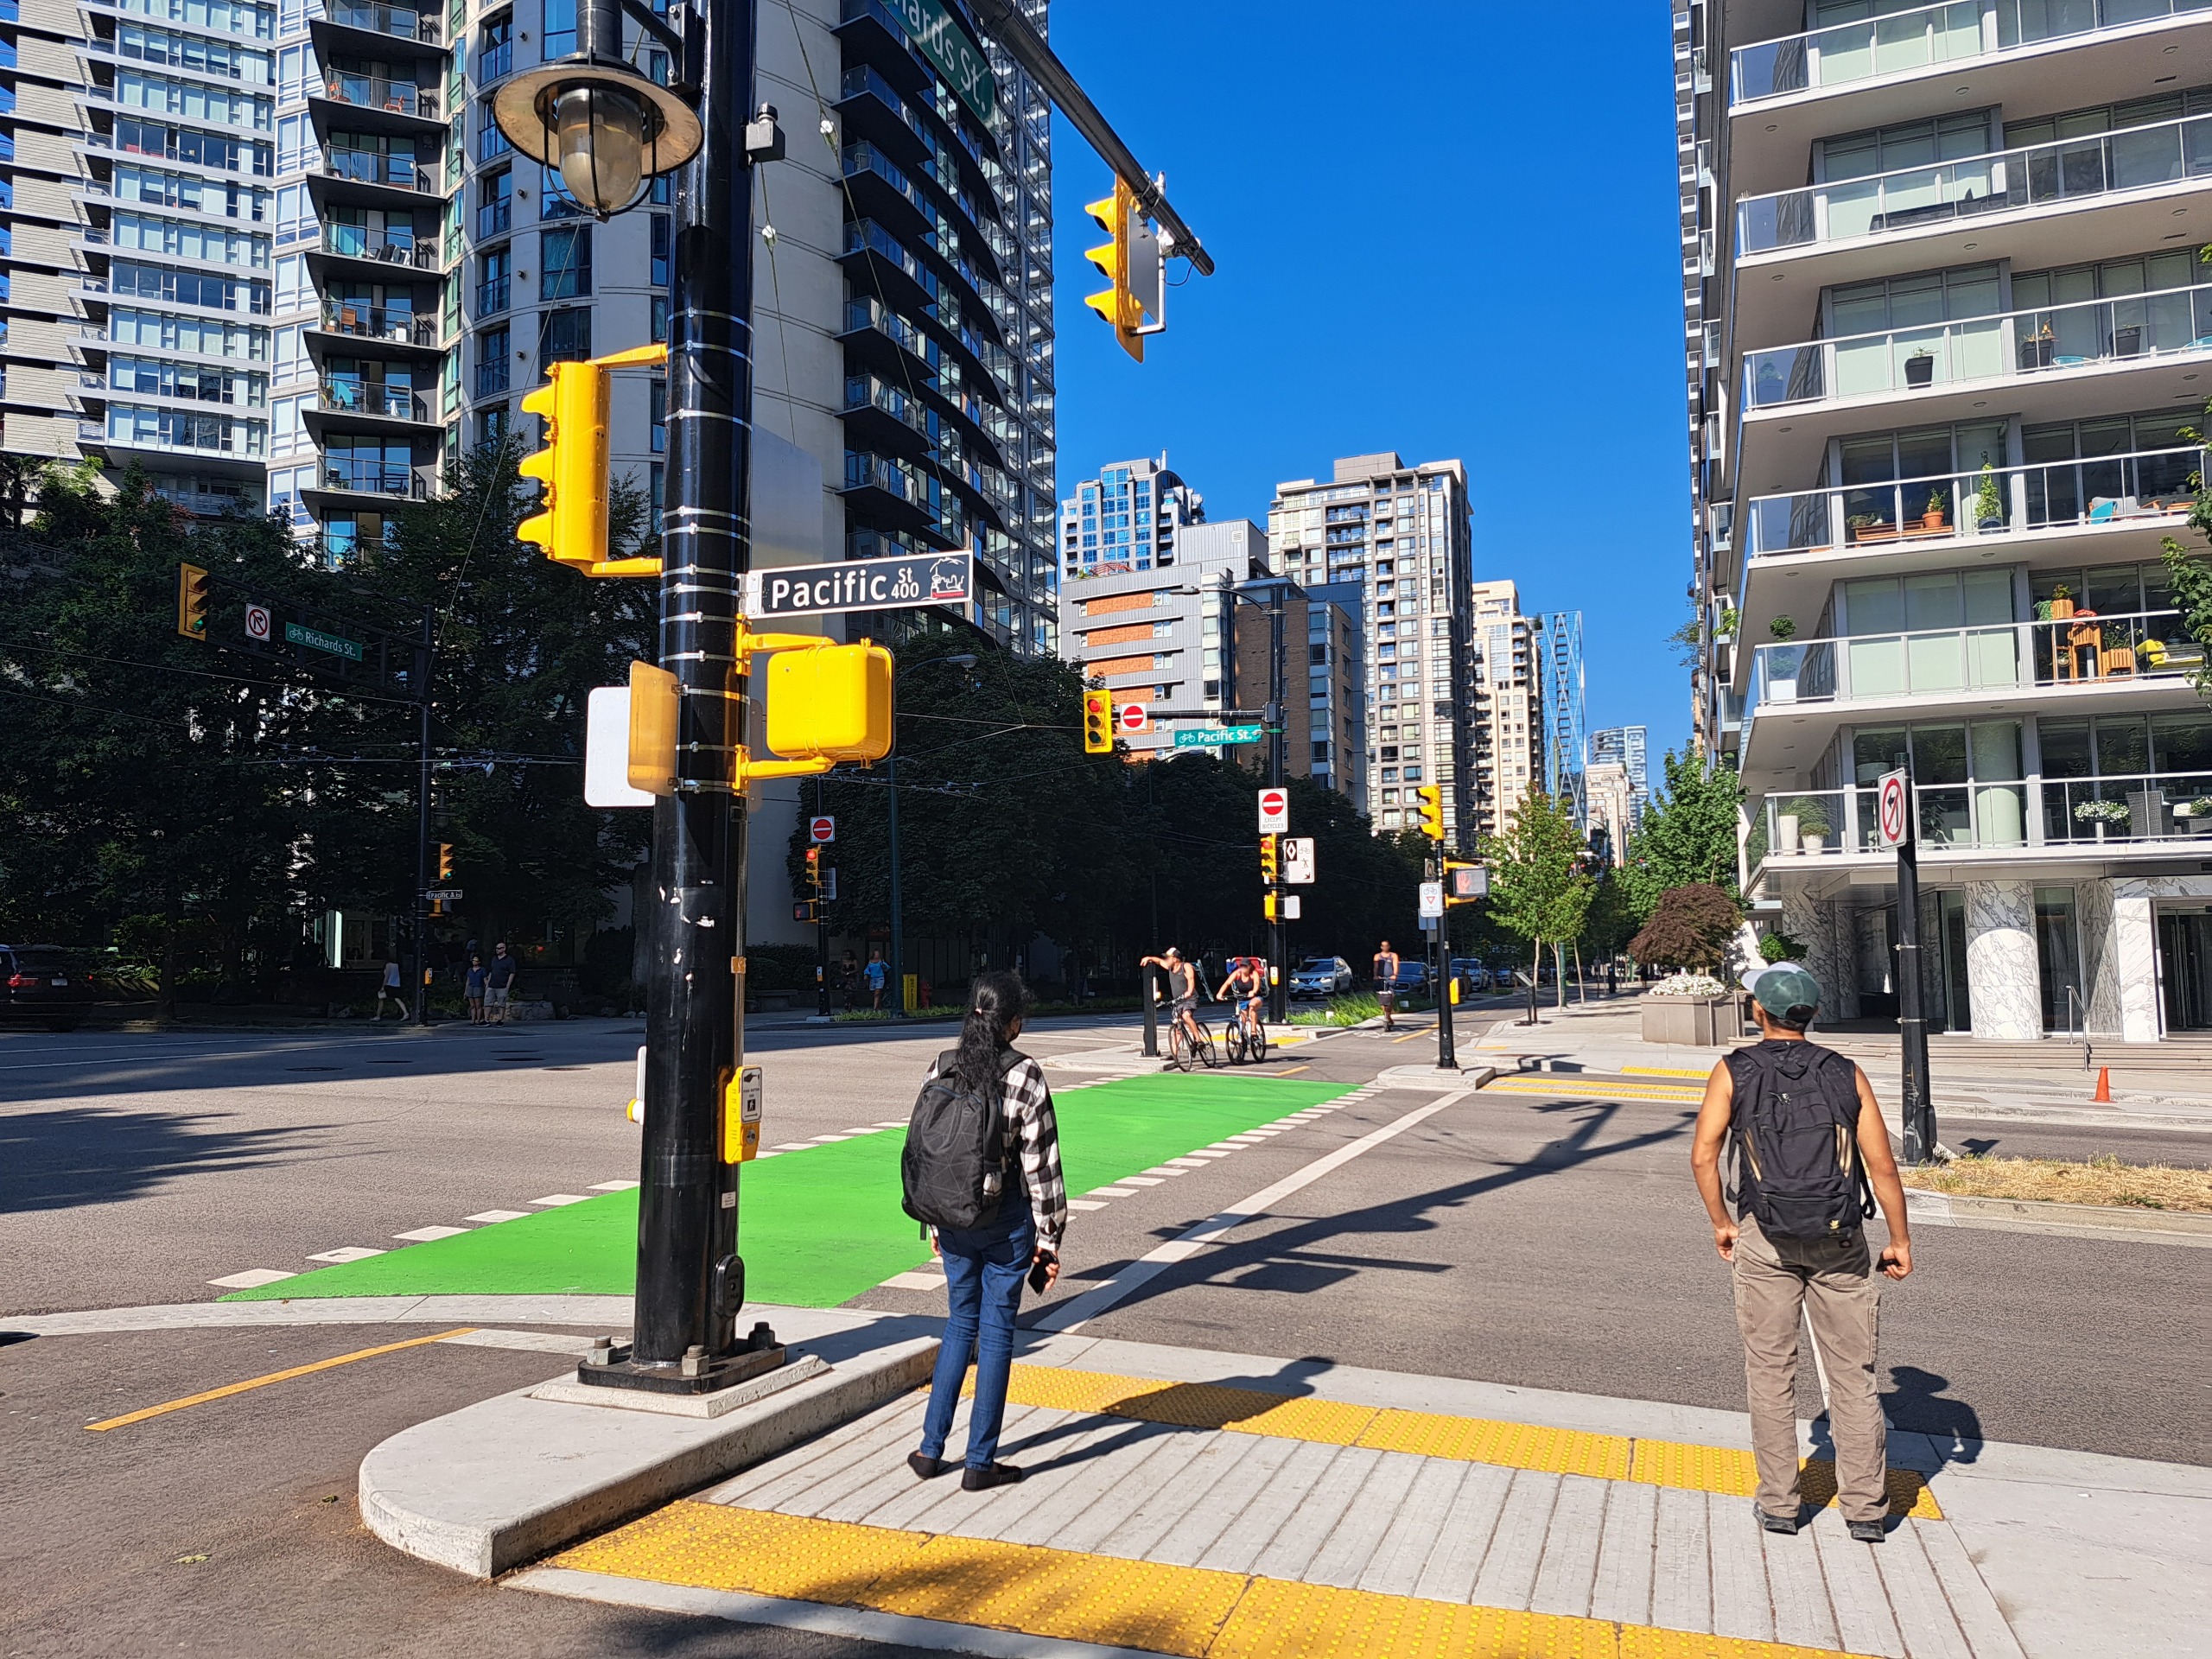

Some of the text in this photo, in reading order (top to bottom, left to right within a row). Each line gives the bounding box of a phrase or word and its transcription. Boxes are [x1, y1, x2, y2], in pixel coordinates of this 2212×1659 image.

[960, 47, 986, 112] St.
[772, 567, 913, 608] Pacific St
[891, 583, 919, 600] 400
[305, 631, 356, 658] Richards St.
[1198, 729, 1252, 744] Pacific St.
